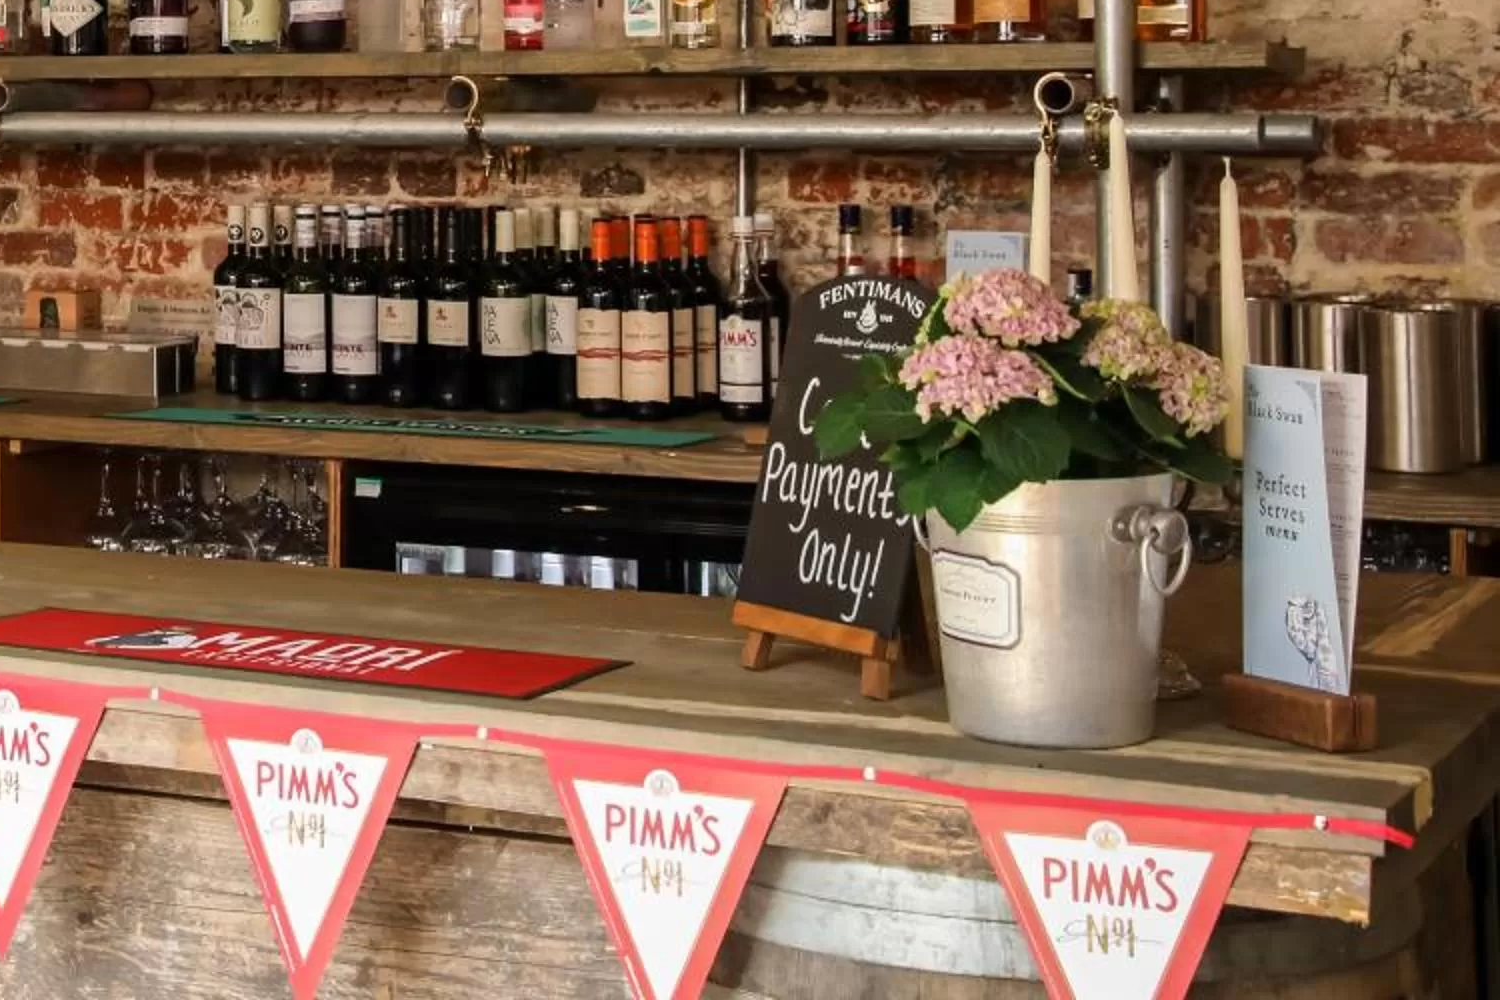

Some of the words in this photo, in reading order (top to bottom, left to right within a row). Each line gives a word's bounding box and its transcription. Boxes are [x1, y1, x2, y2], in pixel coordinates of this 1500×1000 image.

[820, 280, 927, 319] FENTIMANS
[1255, 470, 1307, 499] Perfect
[1259, 497, 1306, 524] Serves
[799, 527, 885, 622] Only!
[256, 760, 359, 808] PIMM'S
[604, 803, 721, 857] PIMM'S
[1042, 856, 1178, 913] PIMM'S
